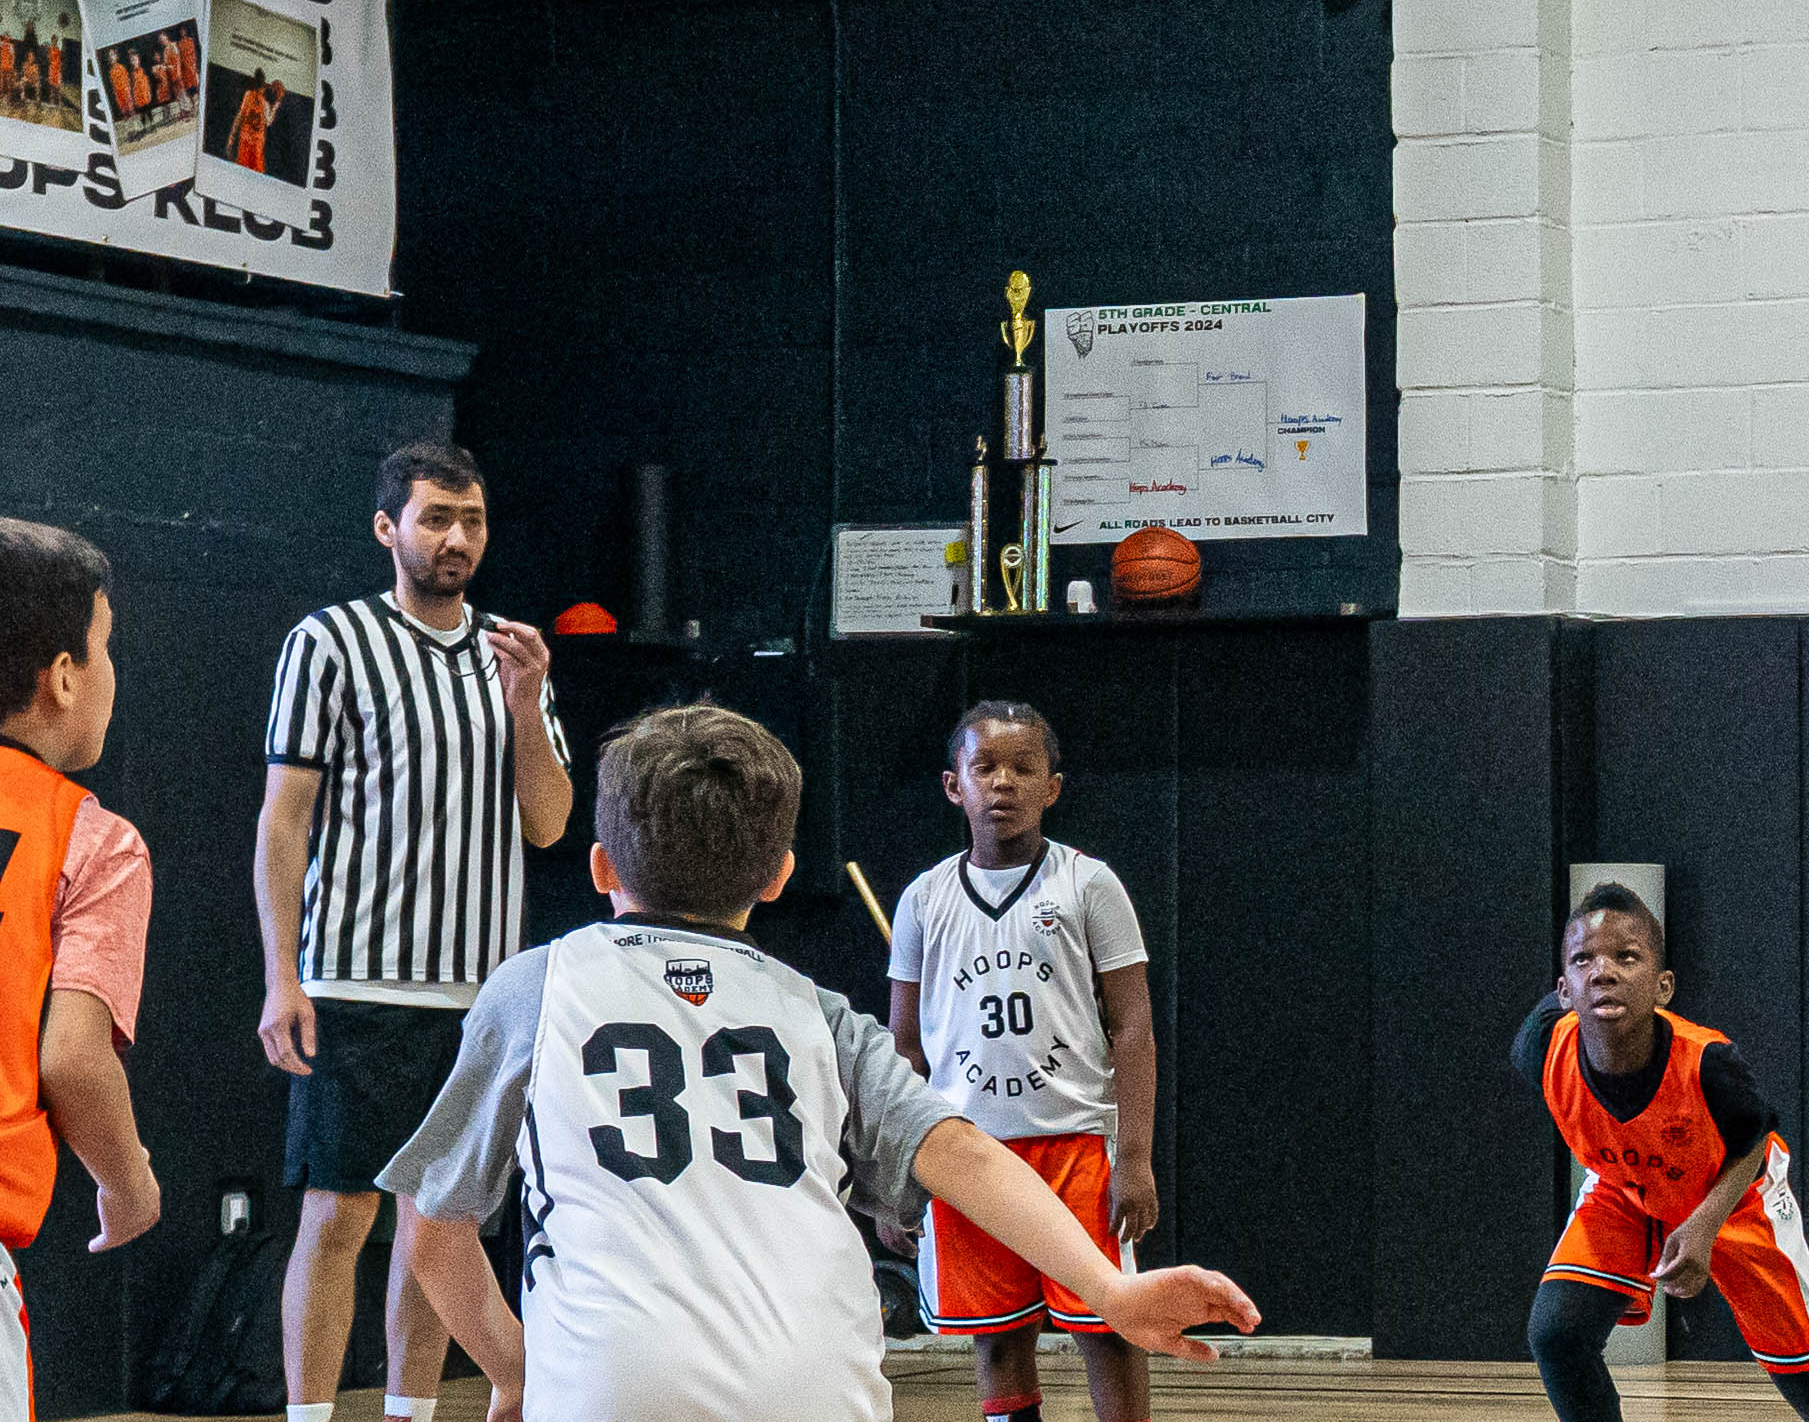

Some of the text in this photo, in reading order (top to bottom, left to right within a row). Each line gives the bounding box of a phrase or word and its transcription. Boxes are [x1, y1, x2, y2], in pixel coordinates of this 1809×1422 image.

[1098, 308, 1128, 320] 5TH
[1132, 305, 1186, 318] GRADE
[1200, 301, 1273, 316] CENTRAL
[1097, 319, 1224, 335] PLAYOFFS 2024
[1277, 426, 1326, 435] CHAMPION
[1099, 513, 1335, 530] ALL ROADS LEAD TO BASKETBALL CITY
[611, 933, 644, 947] ORE
[952, 950, 1054, 992] HOOPS
[979, 991, 1035, 1040] 30
[955, 1034, 1071, 1098] ACADEMY
[580, 1022, 808, 1188] 33
